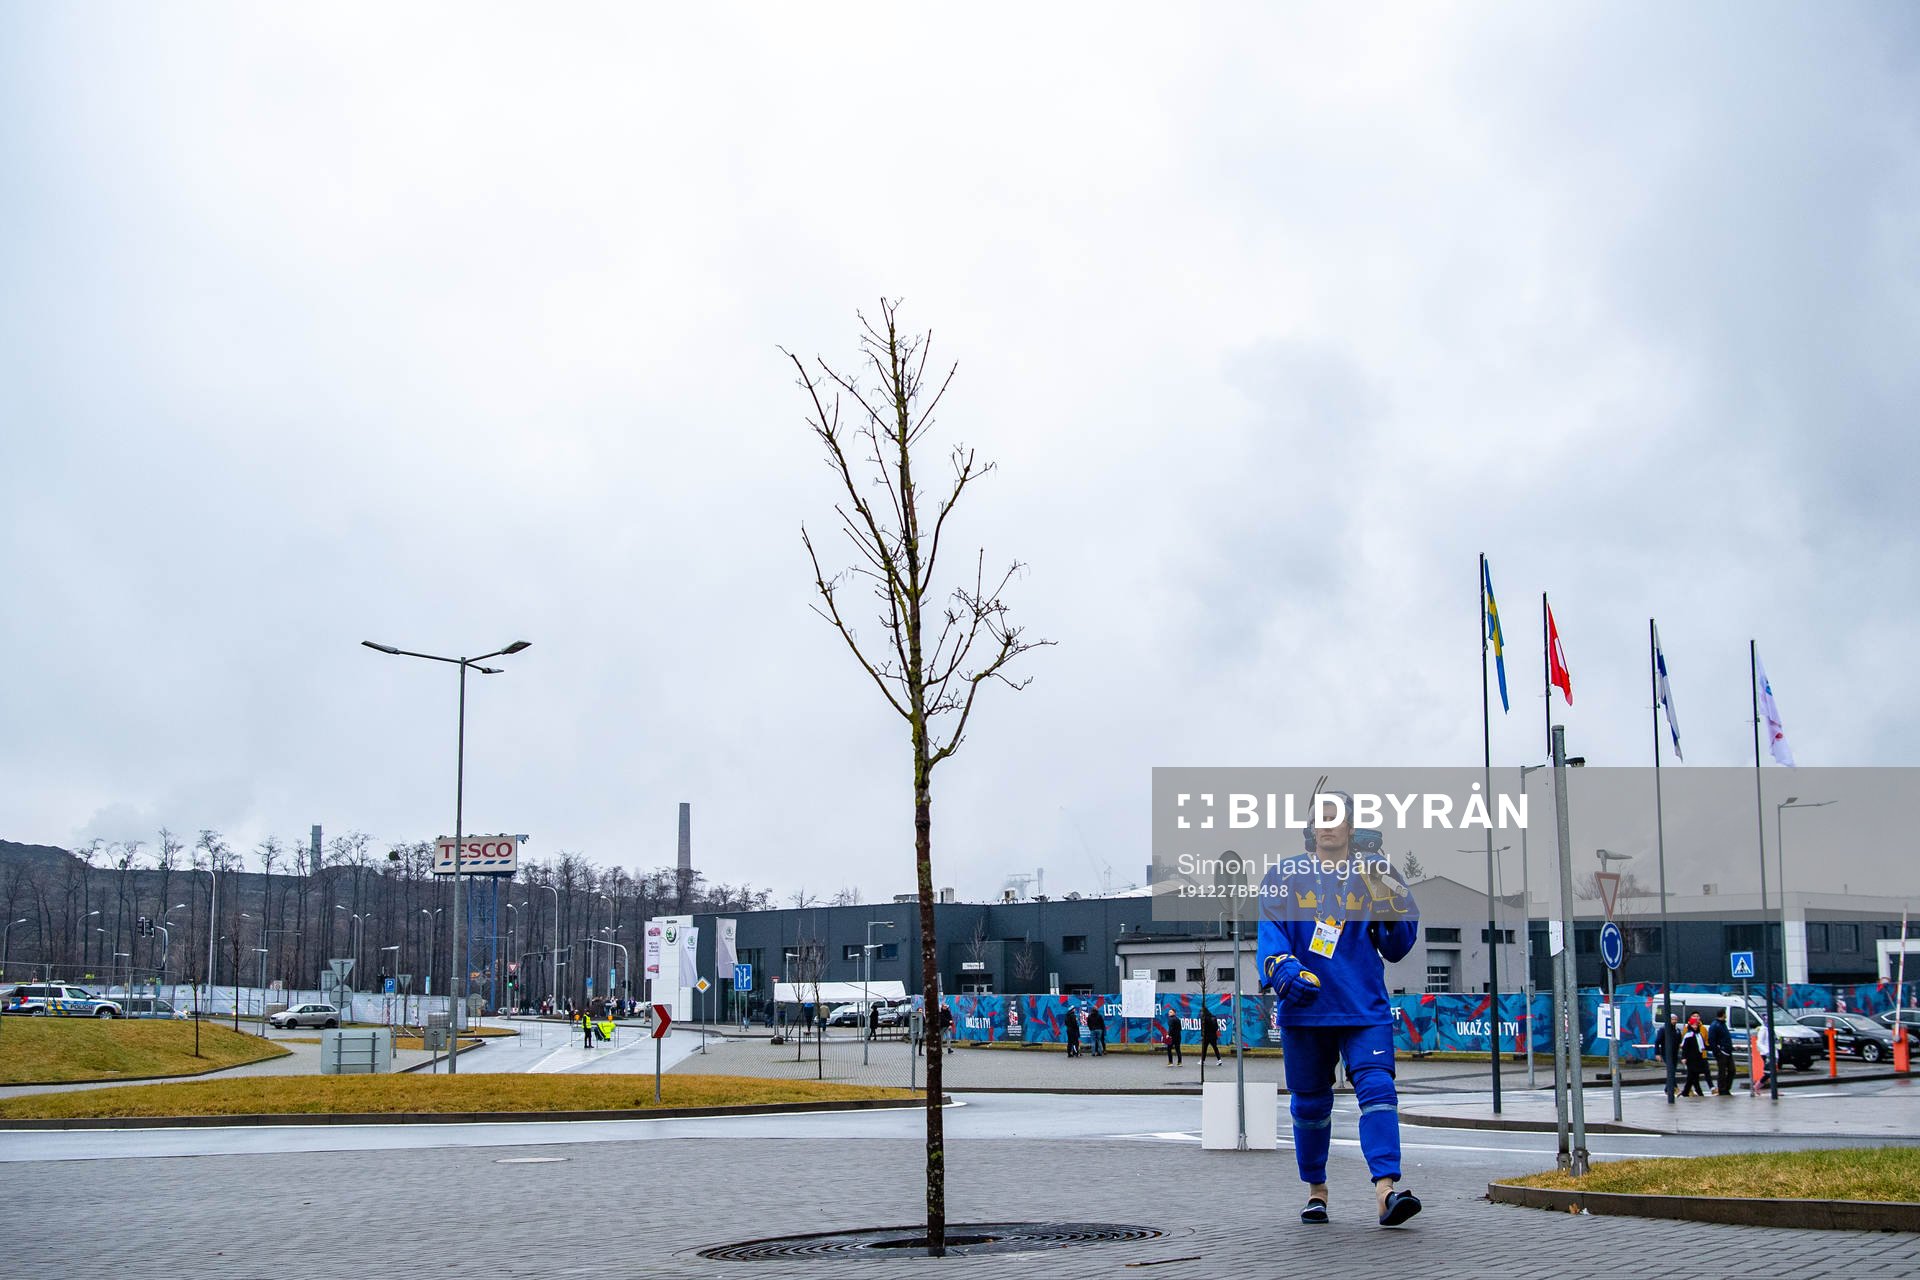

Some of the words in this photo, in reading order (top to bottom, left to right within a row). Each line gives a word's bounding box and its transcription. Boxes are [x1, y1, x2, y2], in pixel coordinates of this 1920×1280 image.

[440, 842, 512, 858] TESCO
[1456, 1018, 1482, 1036] UKAŽ
[1483, 1021, 1492, 1036] S
[1503, 1021, 1519, 1037] TY!
